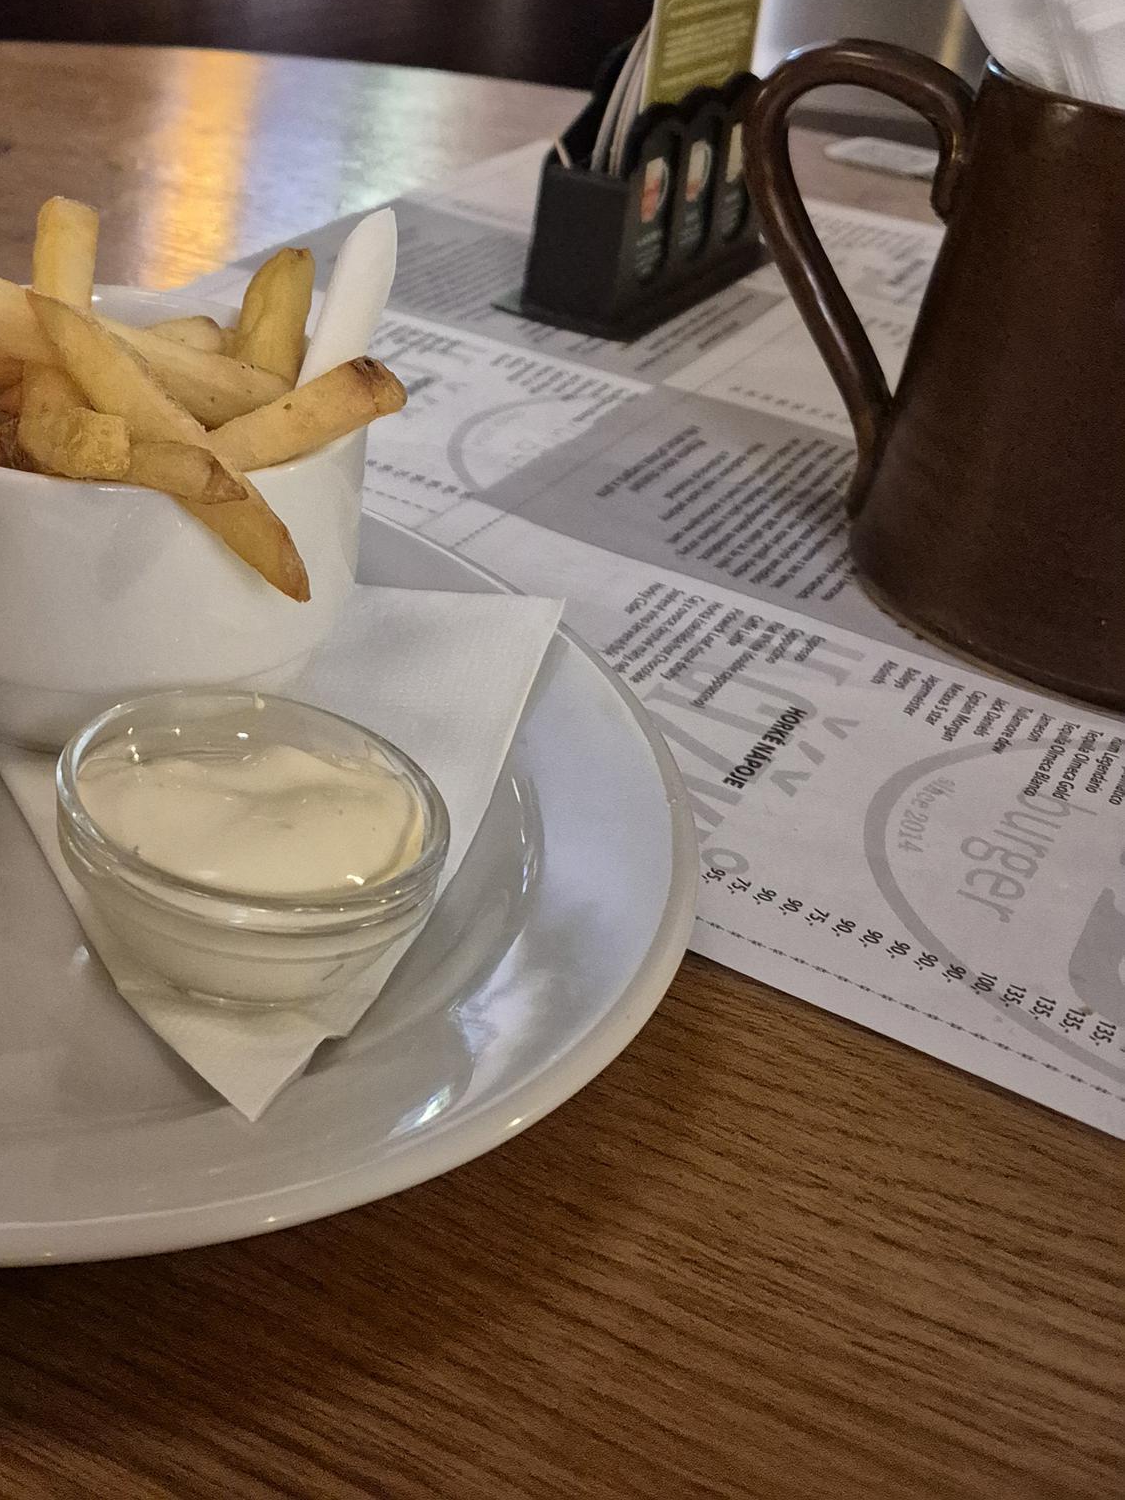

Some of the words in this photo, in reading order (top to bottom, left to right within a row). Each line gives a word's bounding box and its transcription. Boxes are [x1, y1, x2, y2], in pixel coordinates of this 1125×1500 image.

[869, 659, 899, 685] Absinth
[893, 666, 922, 690] Baileys
[937, 681, 965, 706] Metaxa
[959, 689, 988, 715] Captain
[989, 696, 1010, 712] Jack
[761, 706, 807, 746] HORKÉ
[924, 709, 942, 726] star
[940, 712, 971, 742] Morgan
[972, 710, 1001, 737] Daniels
[1000, 705, 1034, 738] Tullamore
[1026, 711, 1056, 743] Jameson
[990, 736, 1012, 754] dew
[1052, 720, 1081, 746] Tequila
[1076, 729, 1104, 754] Tequila
[722, 741, 776, 789] NÁPOJE
[1037, 743, 1066, 772] Olmeca
[1061, 752, 1090, 781] Olmeca
[1022, 770, 1051, 797] Blanco
[1084, 751, 1119, 794] Legendario
[1051, 779, 1075, 801] Gold
[896, 809, 927, 852] 2014
[954, 786, 1099, 924] burger
[700, 866, 726, 884] 95,-
[726, 876, 752, 895] 75,-
[751, 886, 777, 905] 90,-
[777, 896, 803, 916] 90,-
[803, 907, 830, 926] 75,-
[830, 917, 856, 937] 90,-
[857, 928, 884, 948] 90,-
[885, 939, 911, 959] 90,-
[912, 950, 939, 971] 90,-
[941, 962, 967, 983] 90,-
[969, 971, 998, 995] 100,-
[998, 983, 1027, 1008] 135,-
[1027, 995, 1057, 1021] 135,-
[1058, 1007, 1087, 1033] 135,-
[1088, 1020, 1117, 1046] 135,-
